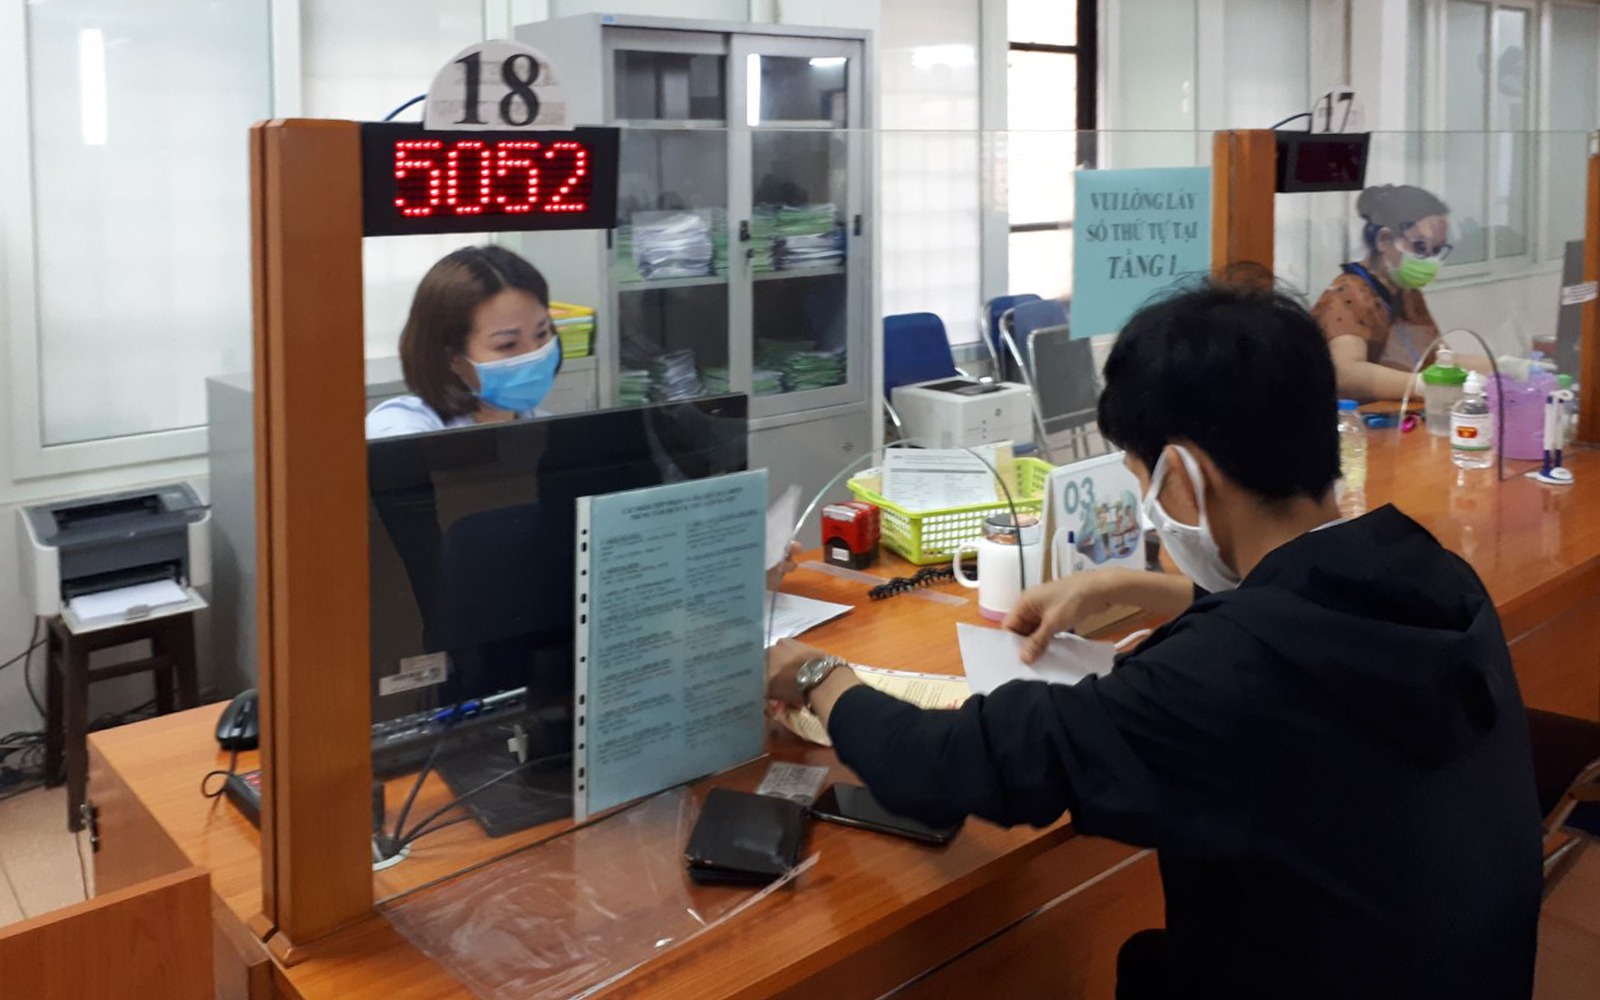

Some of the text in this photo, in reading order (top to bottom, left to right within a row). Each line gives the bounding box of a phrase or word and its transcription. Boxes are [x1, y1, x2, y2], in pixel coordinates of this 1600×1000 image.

[453, 51, 541, 127] 18
[1319, 91, 1355, 133] 17
[394, 140, 585, 216] 5052
[1090, 192, 1119, 211] VUI
[1064, 477, 1095, 514] 03
